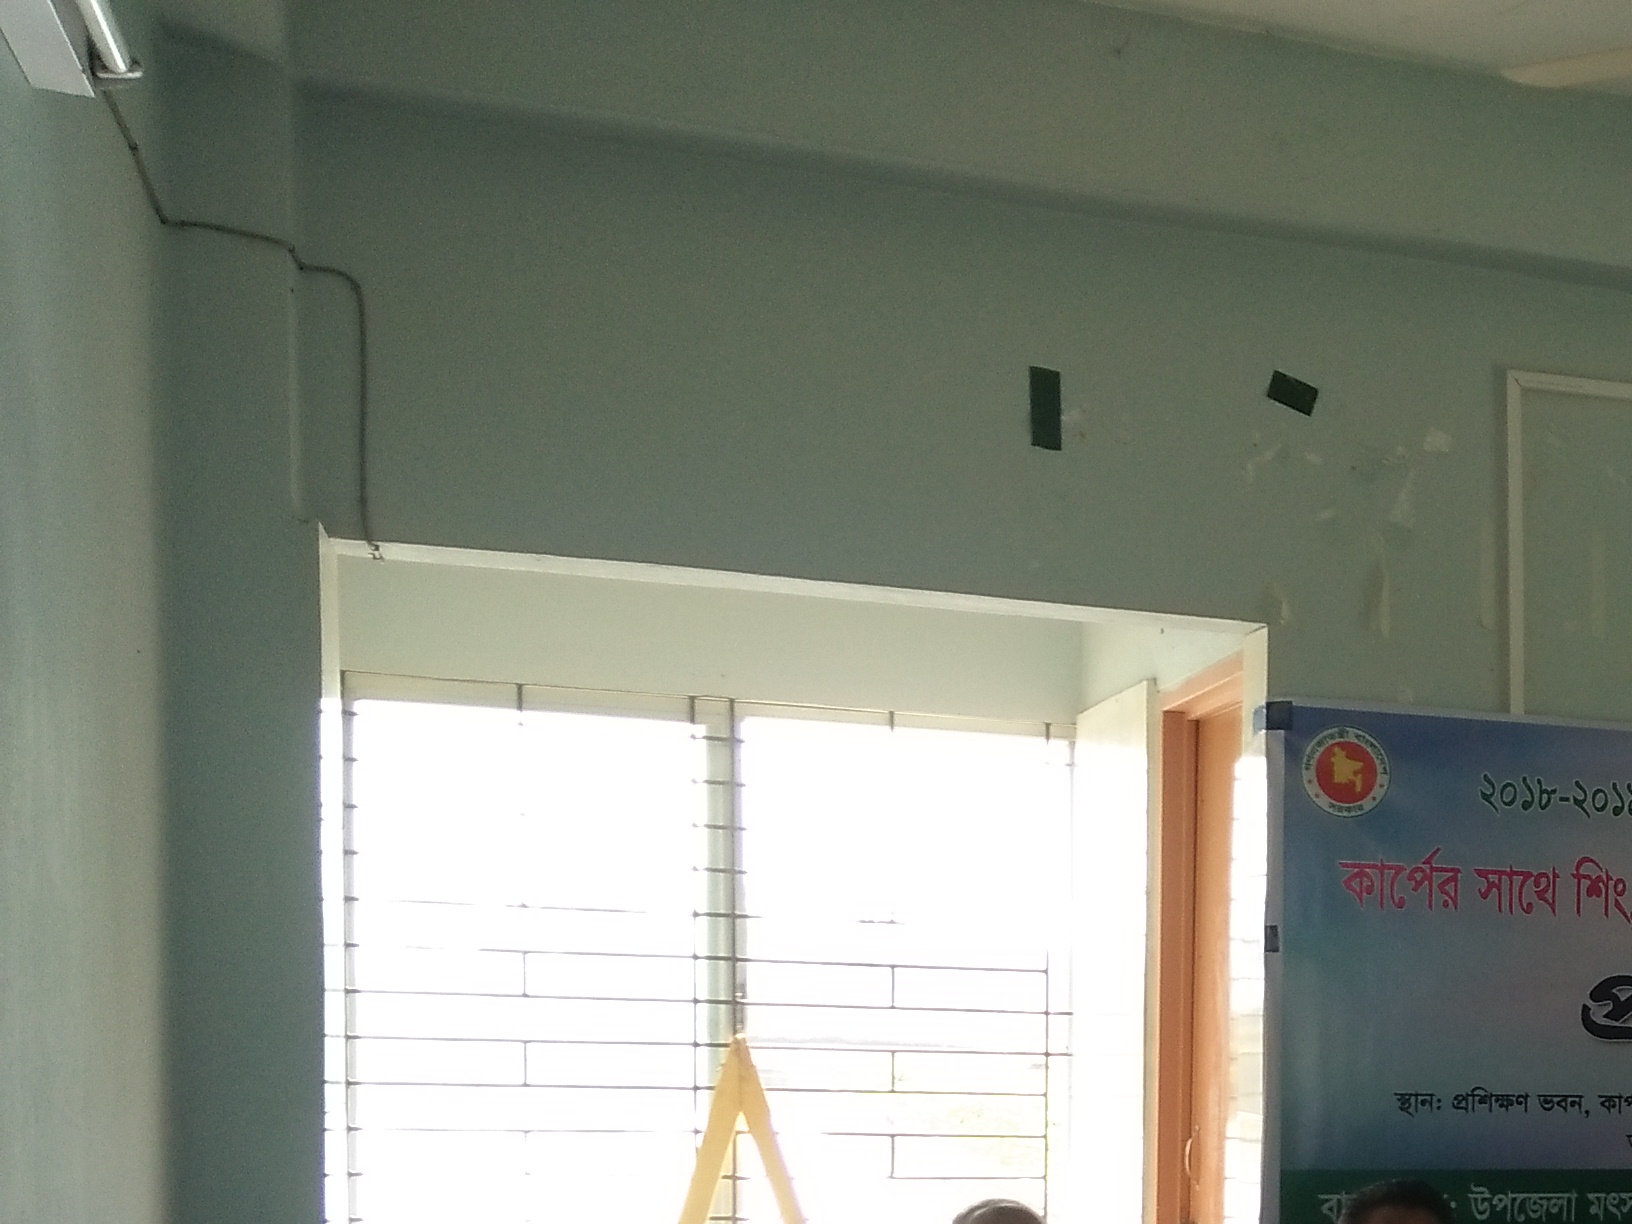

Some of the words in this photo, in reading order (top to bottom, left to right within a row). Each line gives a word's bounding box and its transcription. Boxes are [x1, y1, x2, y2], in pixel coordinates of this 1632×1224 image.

[1339, 847, 1462, 912] কার্পের
[1474, 864, 1560, 916] সাথে
[1452, 1086, 1529, 1115] প্রশিক্ষণ
[1537, 1092, 1590, 1119] ভবন,
[1467, 1182, 1576, 1223] উপজেলা
